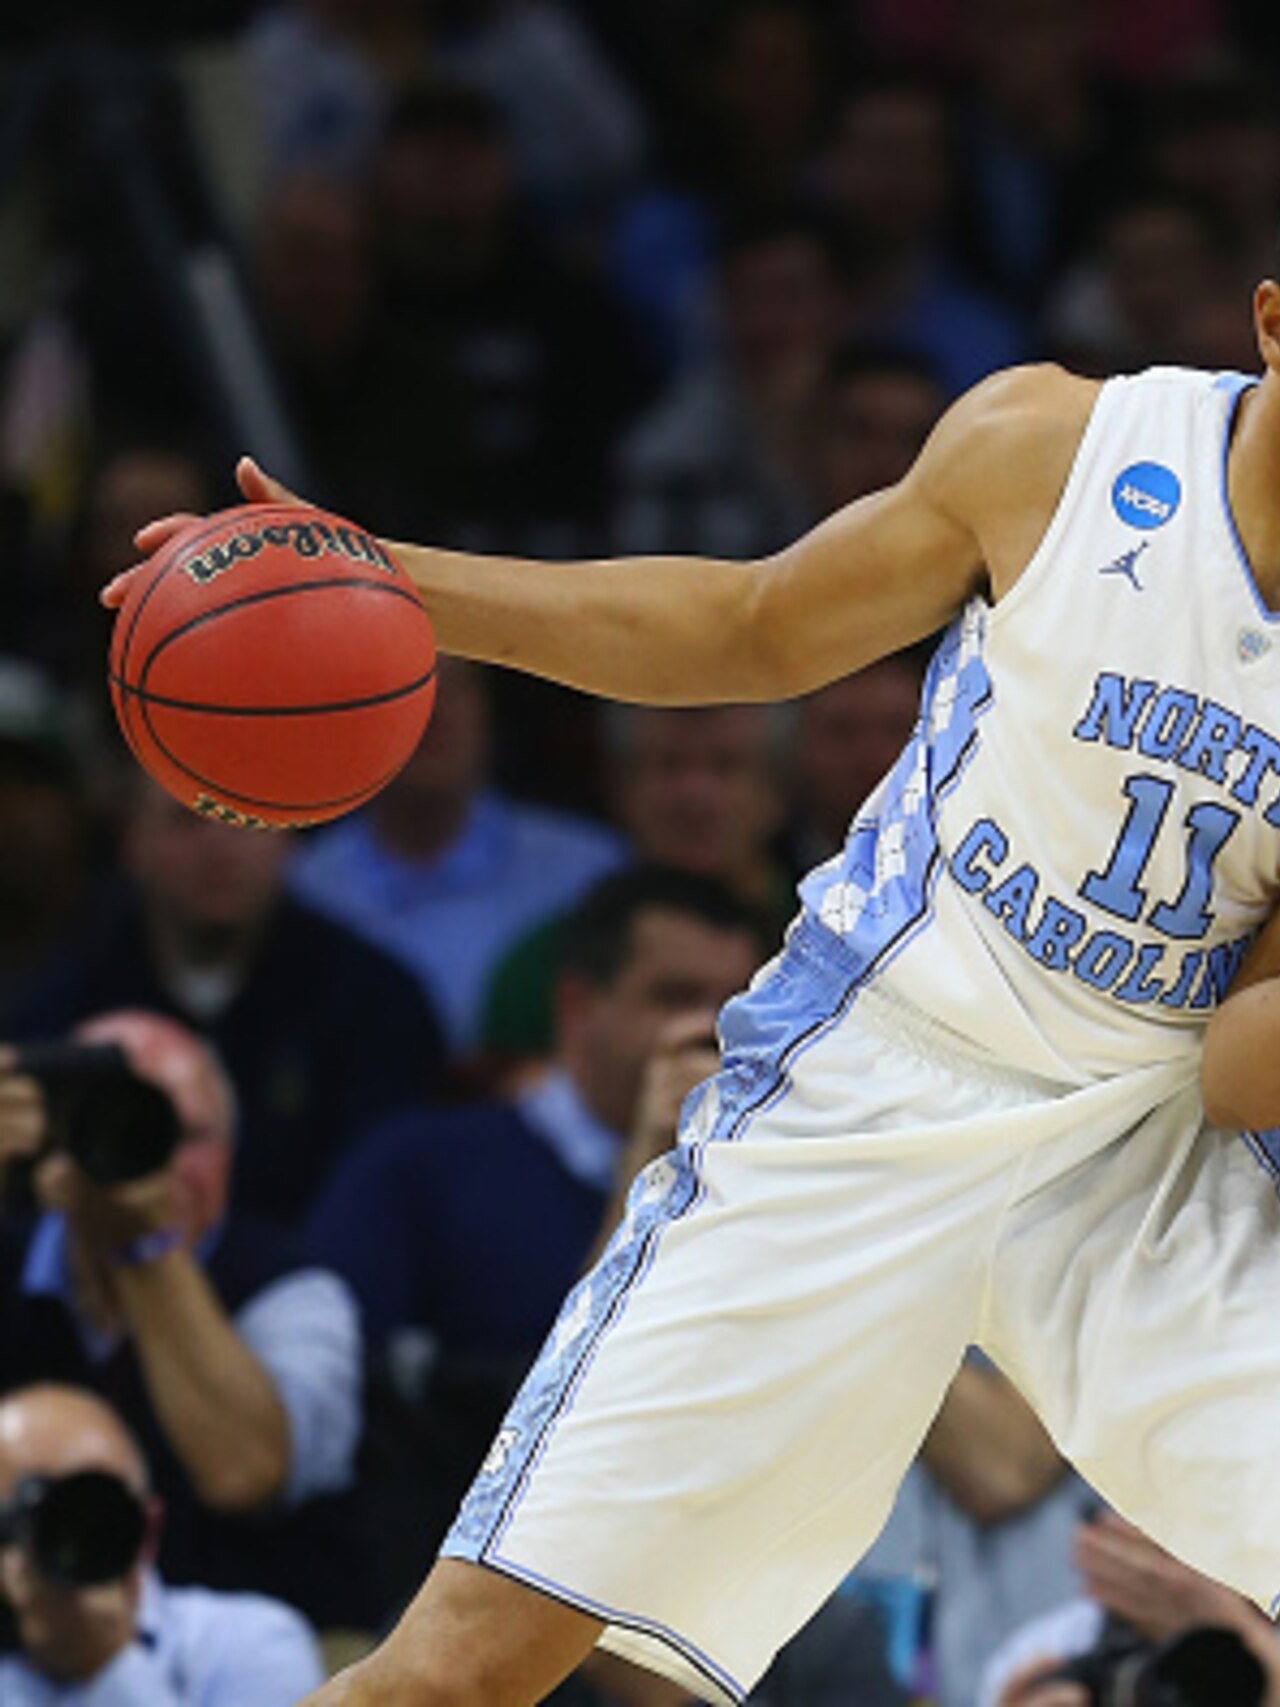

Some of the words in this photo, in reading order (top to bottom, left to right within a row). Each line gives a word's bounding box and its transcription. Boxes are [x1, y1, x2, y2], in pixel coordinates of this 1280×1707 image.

[182, 521, 397, 583] Wilson
[947, 817, 1255, 1010] CAROLIN
[1078, 772, 1243, 940] 11
